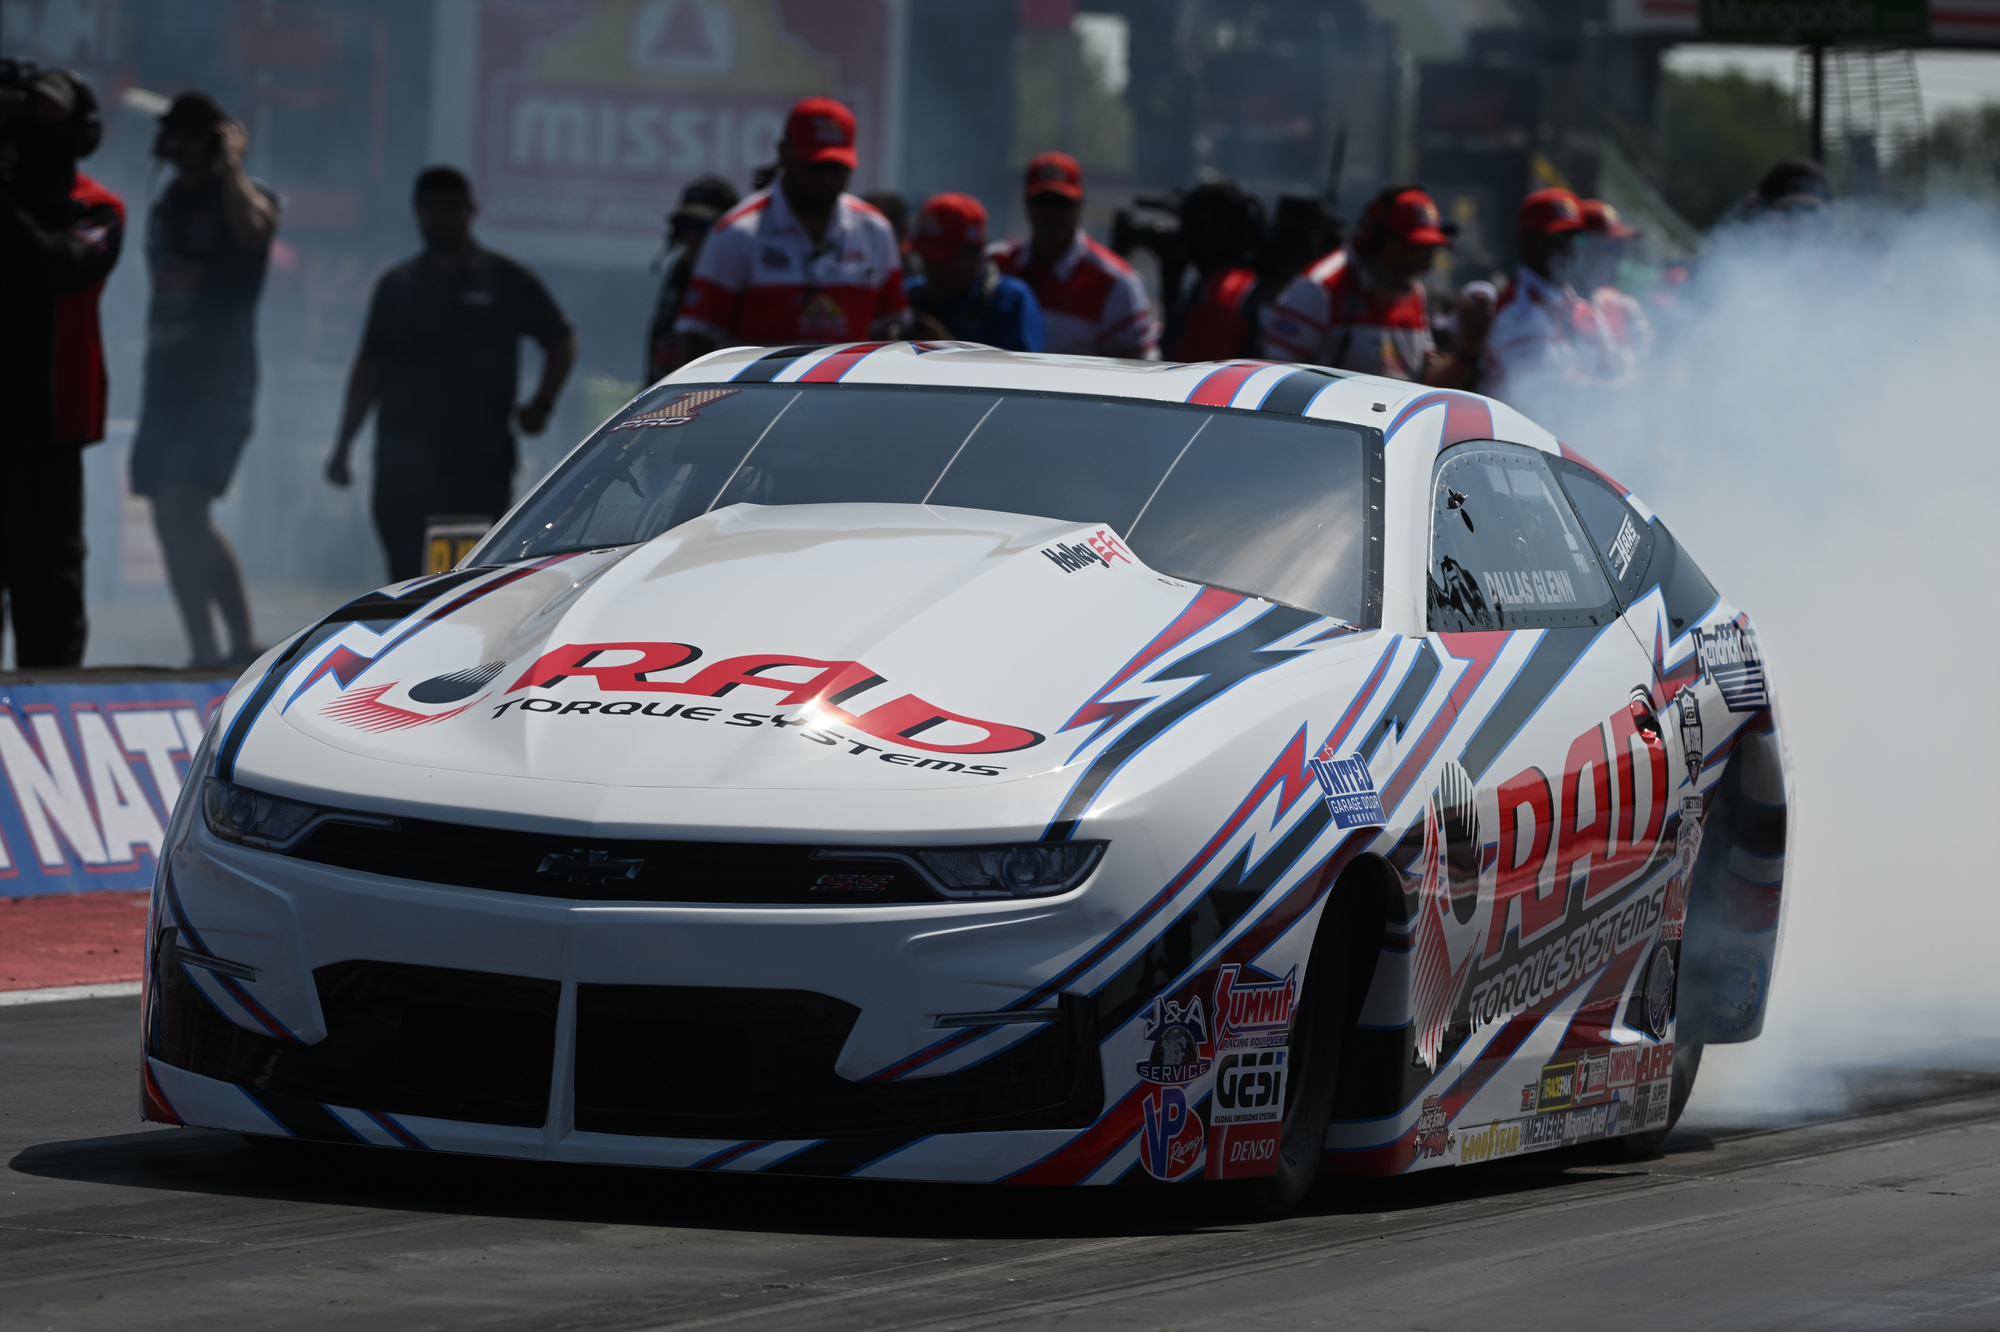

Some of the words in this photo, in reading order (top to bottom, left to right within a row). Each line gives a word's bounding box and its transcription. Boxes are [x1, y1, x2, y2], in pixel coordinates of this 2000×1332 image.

[513, 97, 783, 170] MISSIO
[1040, 542, 1110, 574] Holley
[1086, 530, 1131, 564] EFI
[1609, 513, 1637, 581] HAAS
[1483, 571, 1535, 604] DALLAS
[1532, 570, 1577, 604] GLENN
[504, 642, 1046, 755] RAD
[491, 697, 724, 722] TORQUE
[723, 710, 1008, 777] SYSTEMS
[1309, 753, 1374, 796] UNITED
[1331, 797, 1363, 814] GARAGE
[1361, 795, 1380, 809] DOOR
[1347, 812, 1377, 824] COMPANY
[1481, 701, 1668, 962] RAD
[810, 875, 894, 891] SS
[1662, 922, 1682, 939] TOOLS
[1720, 951, 1760, 965] RACING
[1145, 996, 1206, 1040] J&A
[1215, 972, 1292, 1038] SUMMIT
[1722, 1008, 1757, 1031] SPRINGS
[1224, 1036, 1249, 1049] RACING
[1250, 1034, 1288, 1047] EQUIPMENT
[1139, 1063, 1207, 1082] SERVICE
[1609, 1049, 1637, 1083] SIMPSON
[1637, 1043, 1674, 1082] ARP
[1546, 1074, 1573, 1099] RACEPAK
[1652, 1083, 1668, 1102] SUPER
[1144, 1088, 1187, 1178] VP
[1215, 1114, 1233, 1124] GLOBAL
[1233, 1113, 1258, 1123] EMISSIONS
[1259, 1112, 1277, 1121] SYSTEMS
[1525, 1114, 1564, 1145] MEZIERE
[1563, 1106, 1608, 1145] MagnaFuel
[1169, 1135, 1203, 1169] Racing
[1230, 1138, 1275, 1162] DENSO
